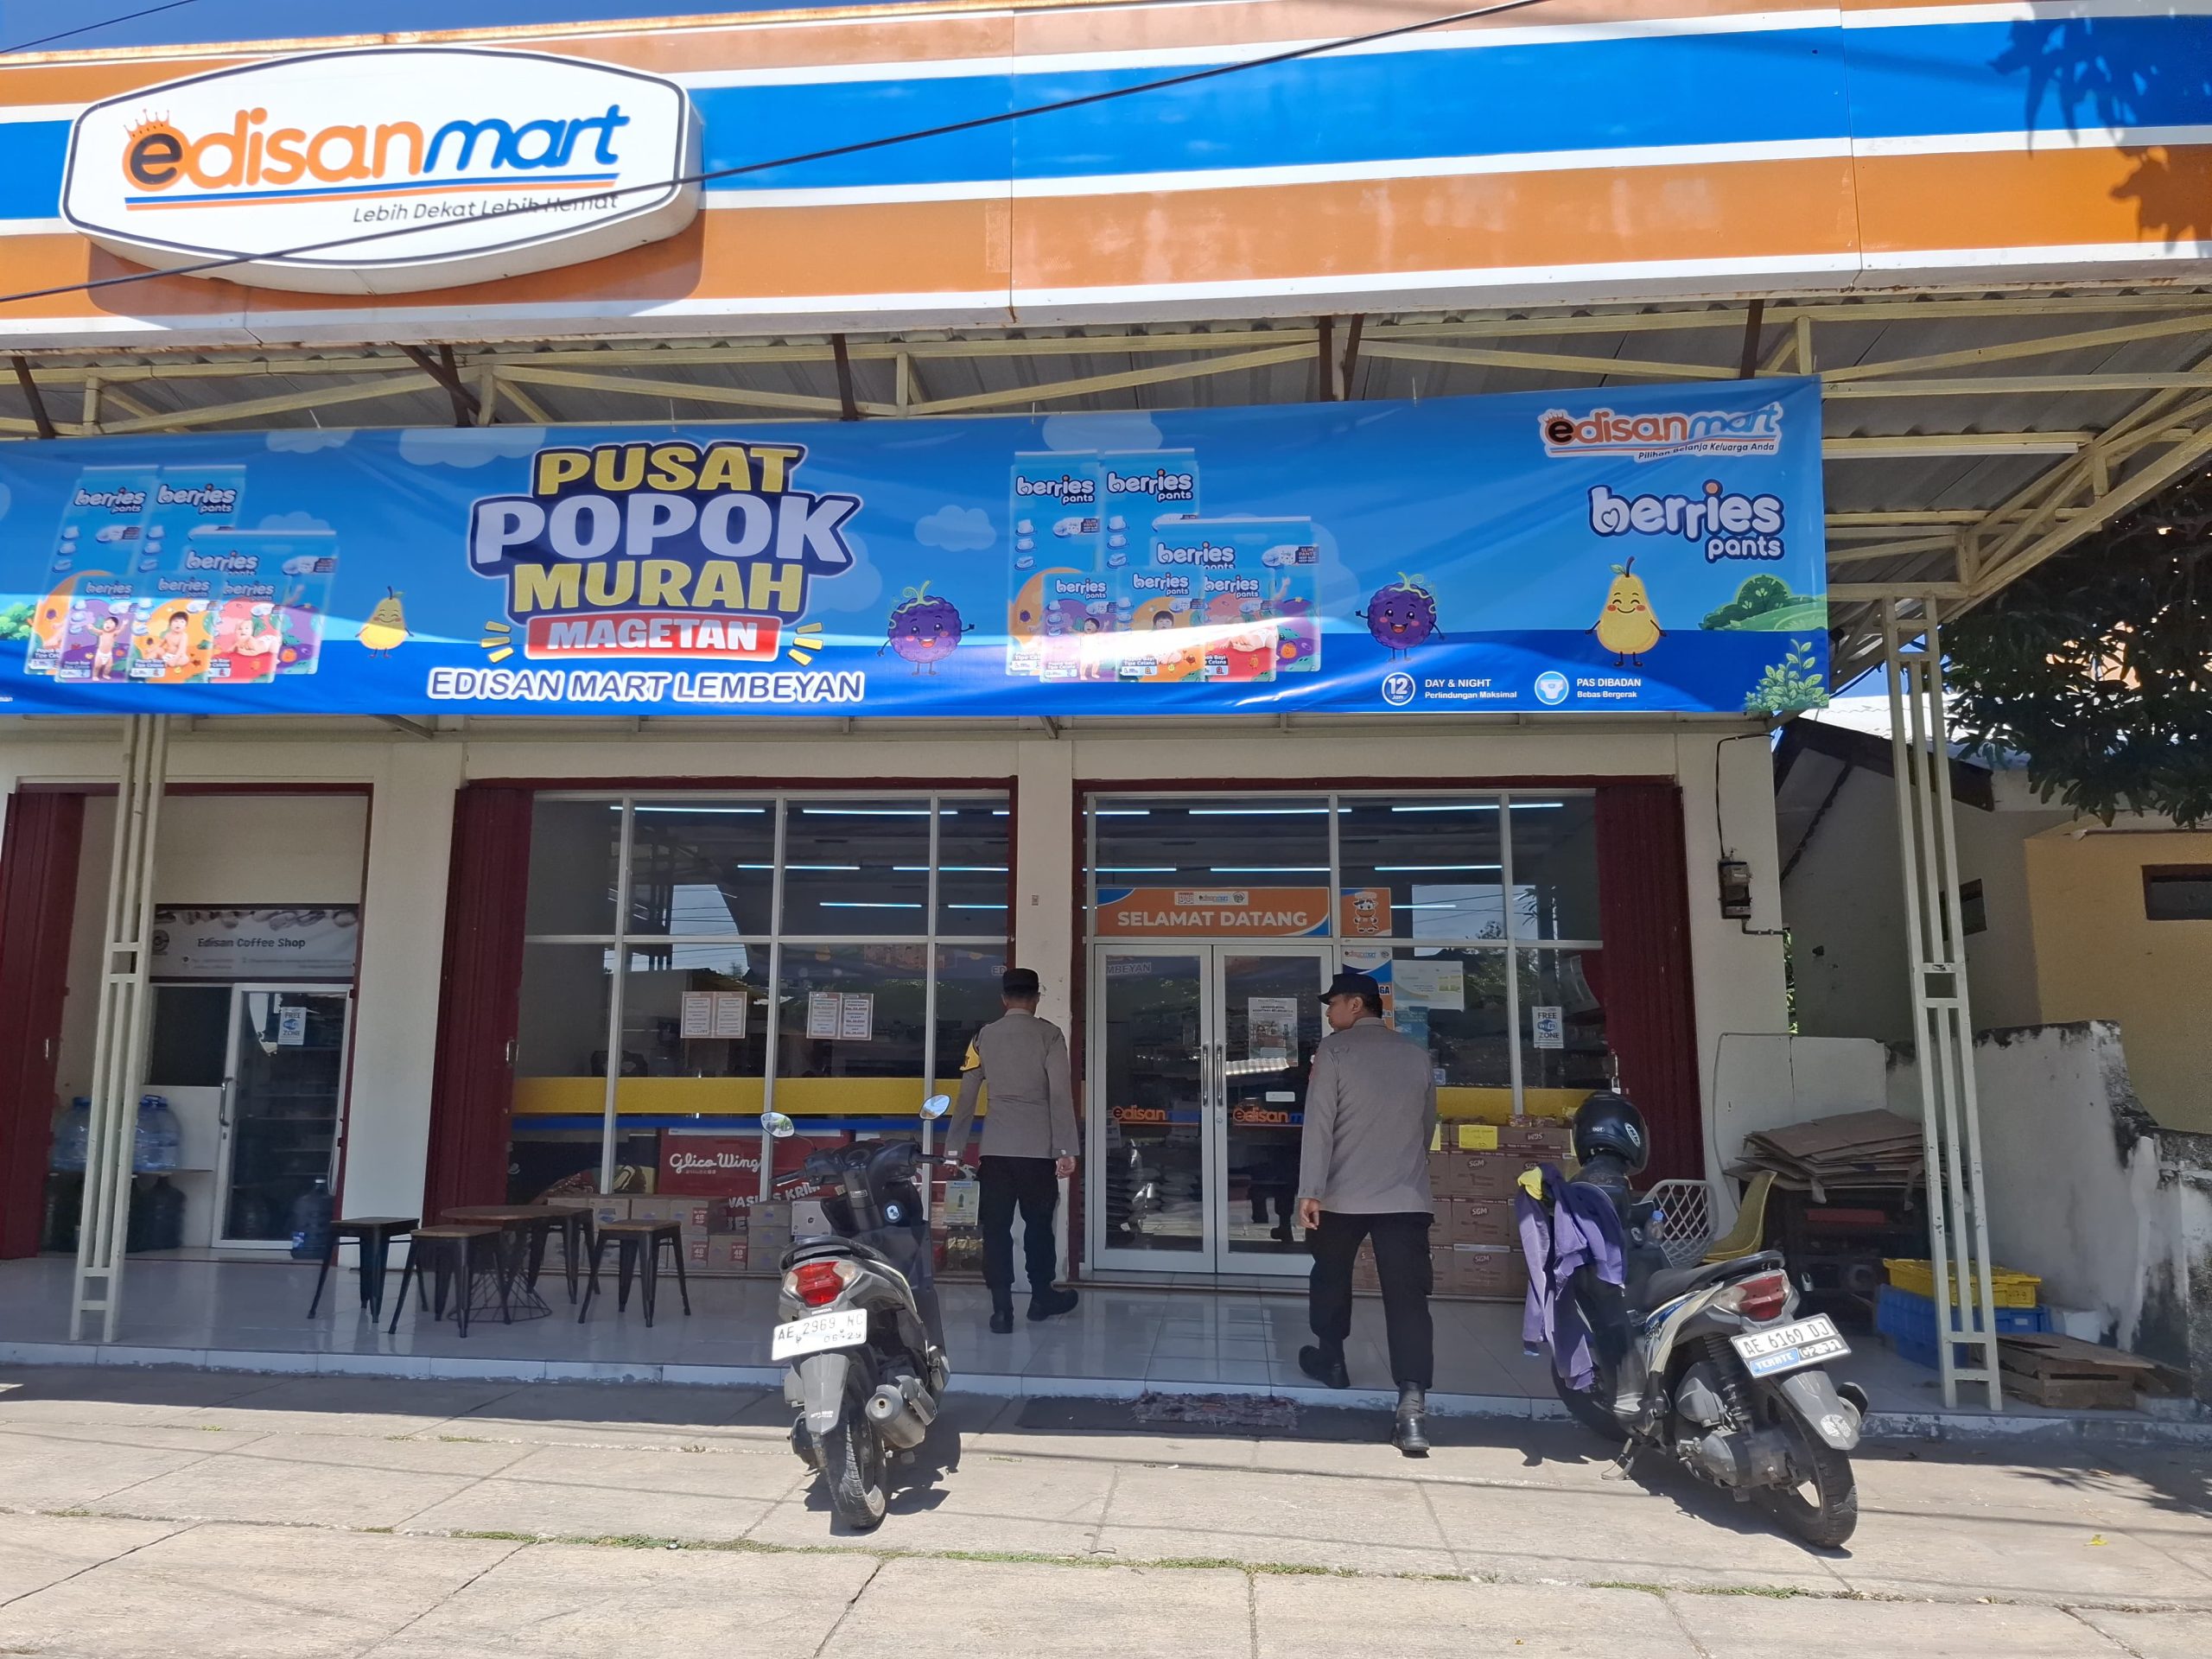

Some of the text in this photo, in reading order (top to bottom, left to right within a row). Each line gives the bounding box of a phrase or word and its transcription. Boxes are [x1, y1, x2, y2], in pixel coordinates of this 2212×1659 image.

[353, 204, 408, 223] Lebih
[413, 200, 475, 219] Dekat
[481, 198, 539, 215] Lebih
[1639, 450, 1670, 460] Pilihan
[1710, 442, 1748, 453] Keluarga
[1751, 442, 1775, 451] Anda
[539, 447, 799, 495] PUSAT
[1107, 468, 1193, 495] berries
[74, 486, 146, 508] berries
[157, 483, 237, 508] berries
[1016, 475, 1095, 498] berries
[1157, 489, 1193, 502] pants
[111, 504, 143, 515] pants
[199, 504, 232, 514] pants
[1062, 494, 1095, 505] pants
[1590, 480, 1783, 542] berries
[476, 493, 855, 565] POPOK
[1157, 541, 1235, 565] berries
[1707, 535, 1783, 563] pants
[186, 550, 258, 572] berries
[158, 576, 210, 594] berries
[223, 581, 275, 598] berries
[514, 560, 804, 613] MURAH
[1055, 578, 1107, 594] berries
[1134, 572, 1189, 590] berries
[1205, 575, 1259, 594] berries
[547, 619, 757, 651] MAGETAN
[430, 671, 861, 701] EDISAN MART LEMBEYAN
[1389, 677, 1408, 695] 12
[1425, 678, 1491, 688] DAY & NIGHT
[1576, 678, 1641, 687] PAS DIBADAN
[1425, 691, 1478, 700] Perlindungan
[1117, 912, 1308, 927] SELAMAT DATANG
[198, 938, 306, 950] Edisan Coffee Shop
[670, 1153, 762, 1174] Glico Wing
[778, 1313, 863, 1340] AE 2969 NC
[1743, 1321, 1830, 1356] AE 6169 DJ
